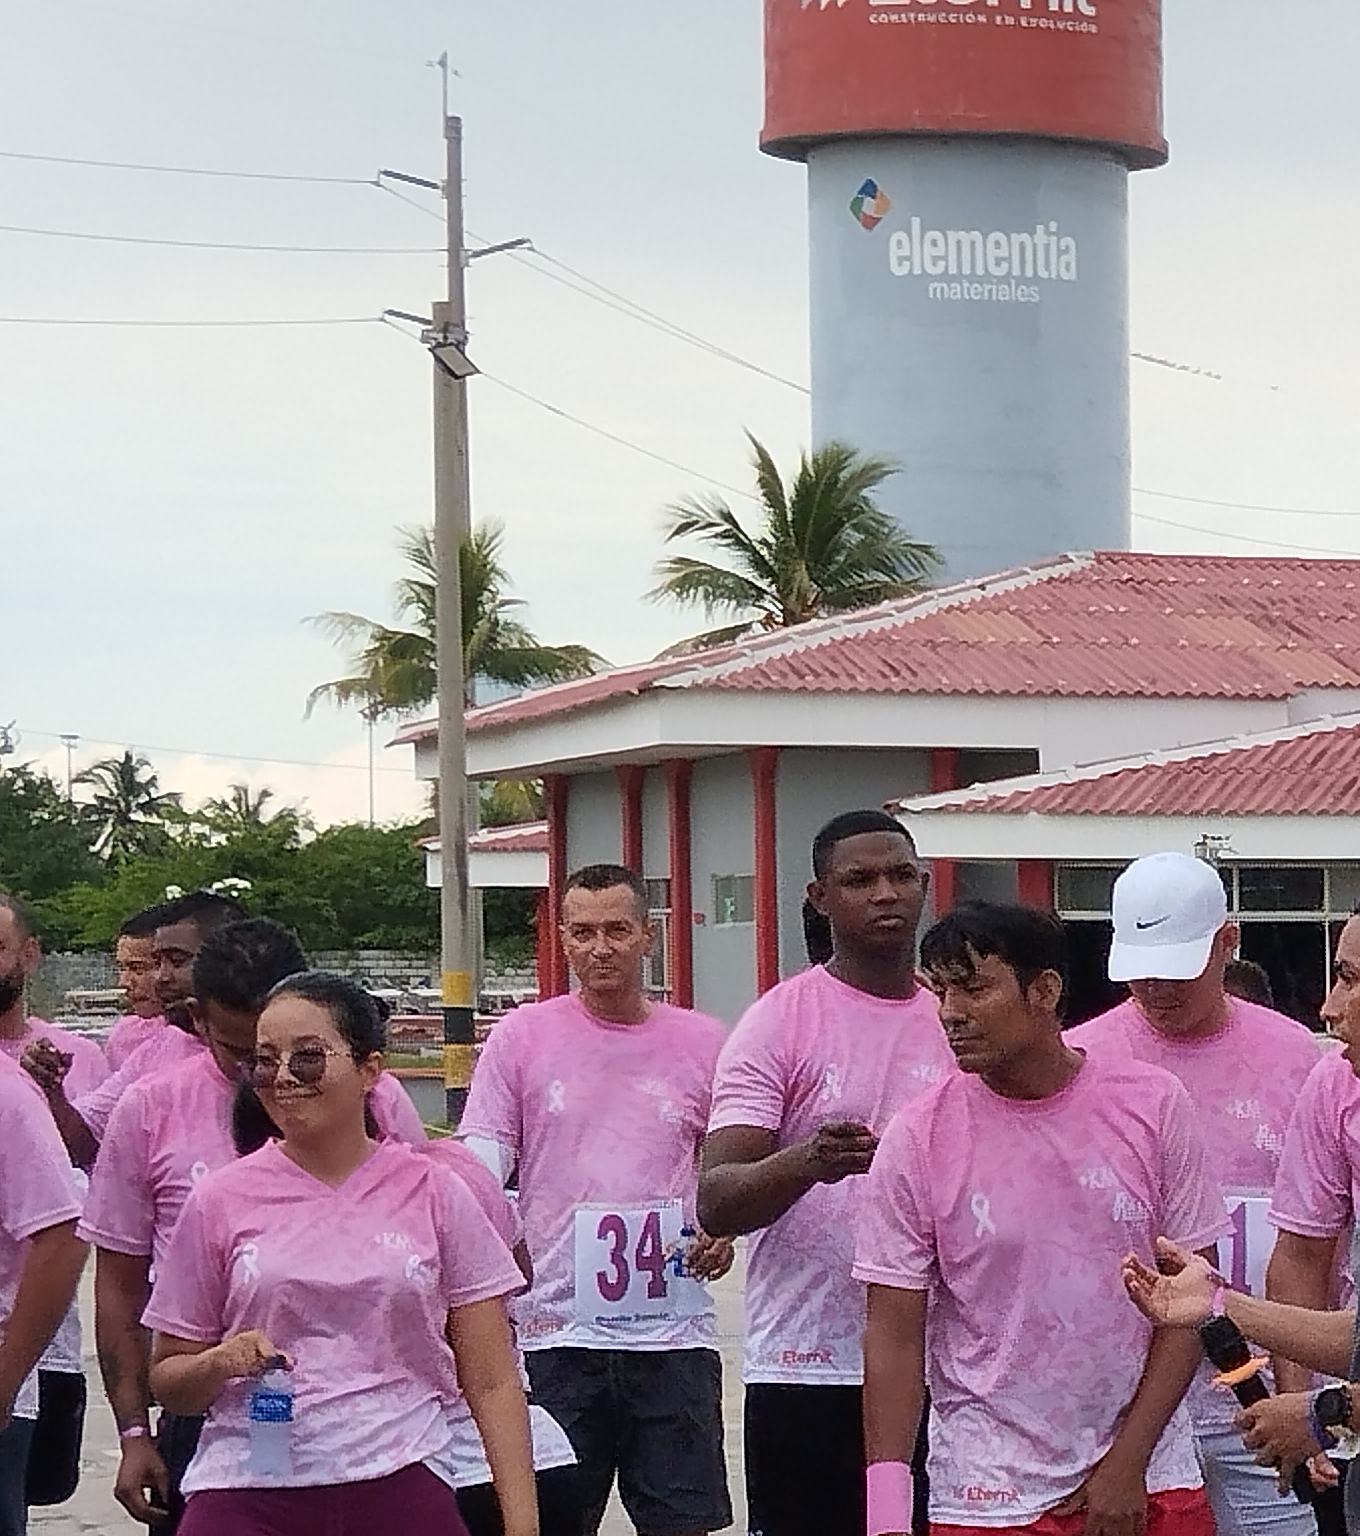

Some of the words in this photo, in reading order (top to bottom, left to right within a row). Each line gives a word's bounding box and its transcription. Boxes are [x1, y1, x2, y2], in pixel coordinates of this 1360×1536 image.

[889, 216, 1076, 281] elementia
[927, 279, 1040, 302] materiales
[596, 1211, 667, 1301] 34
